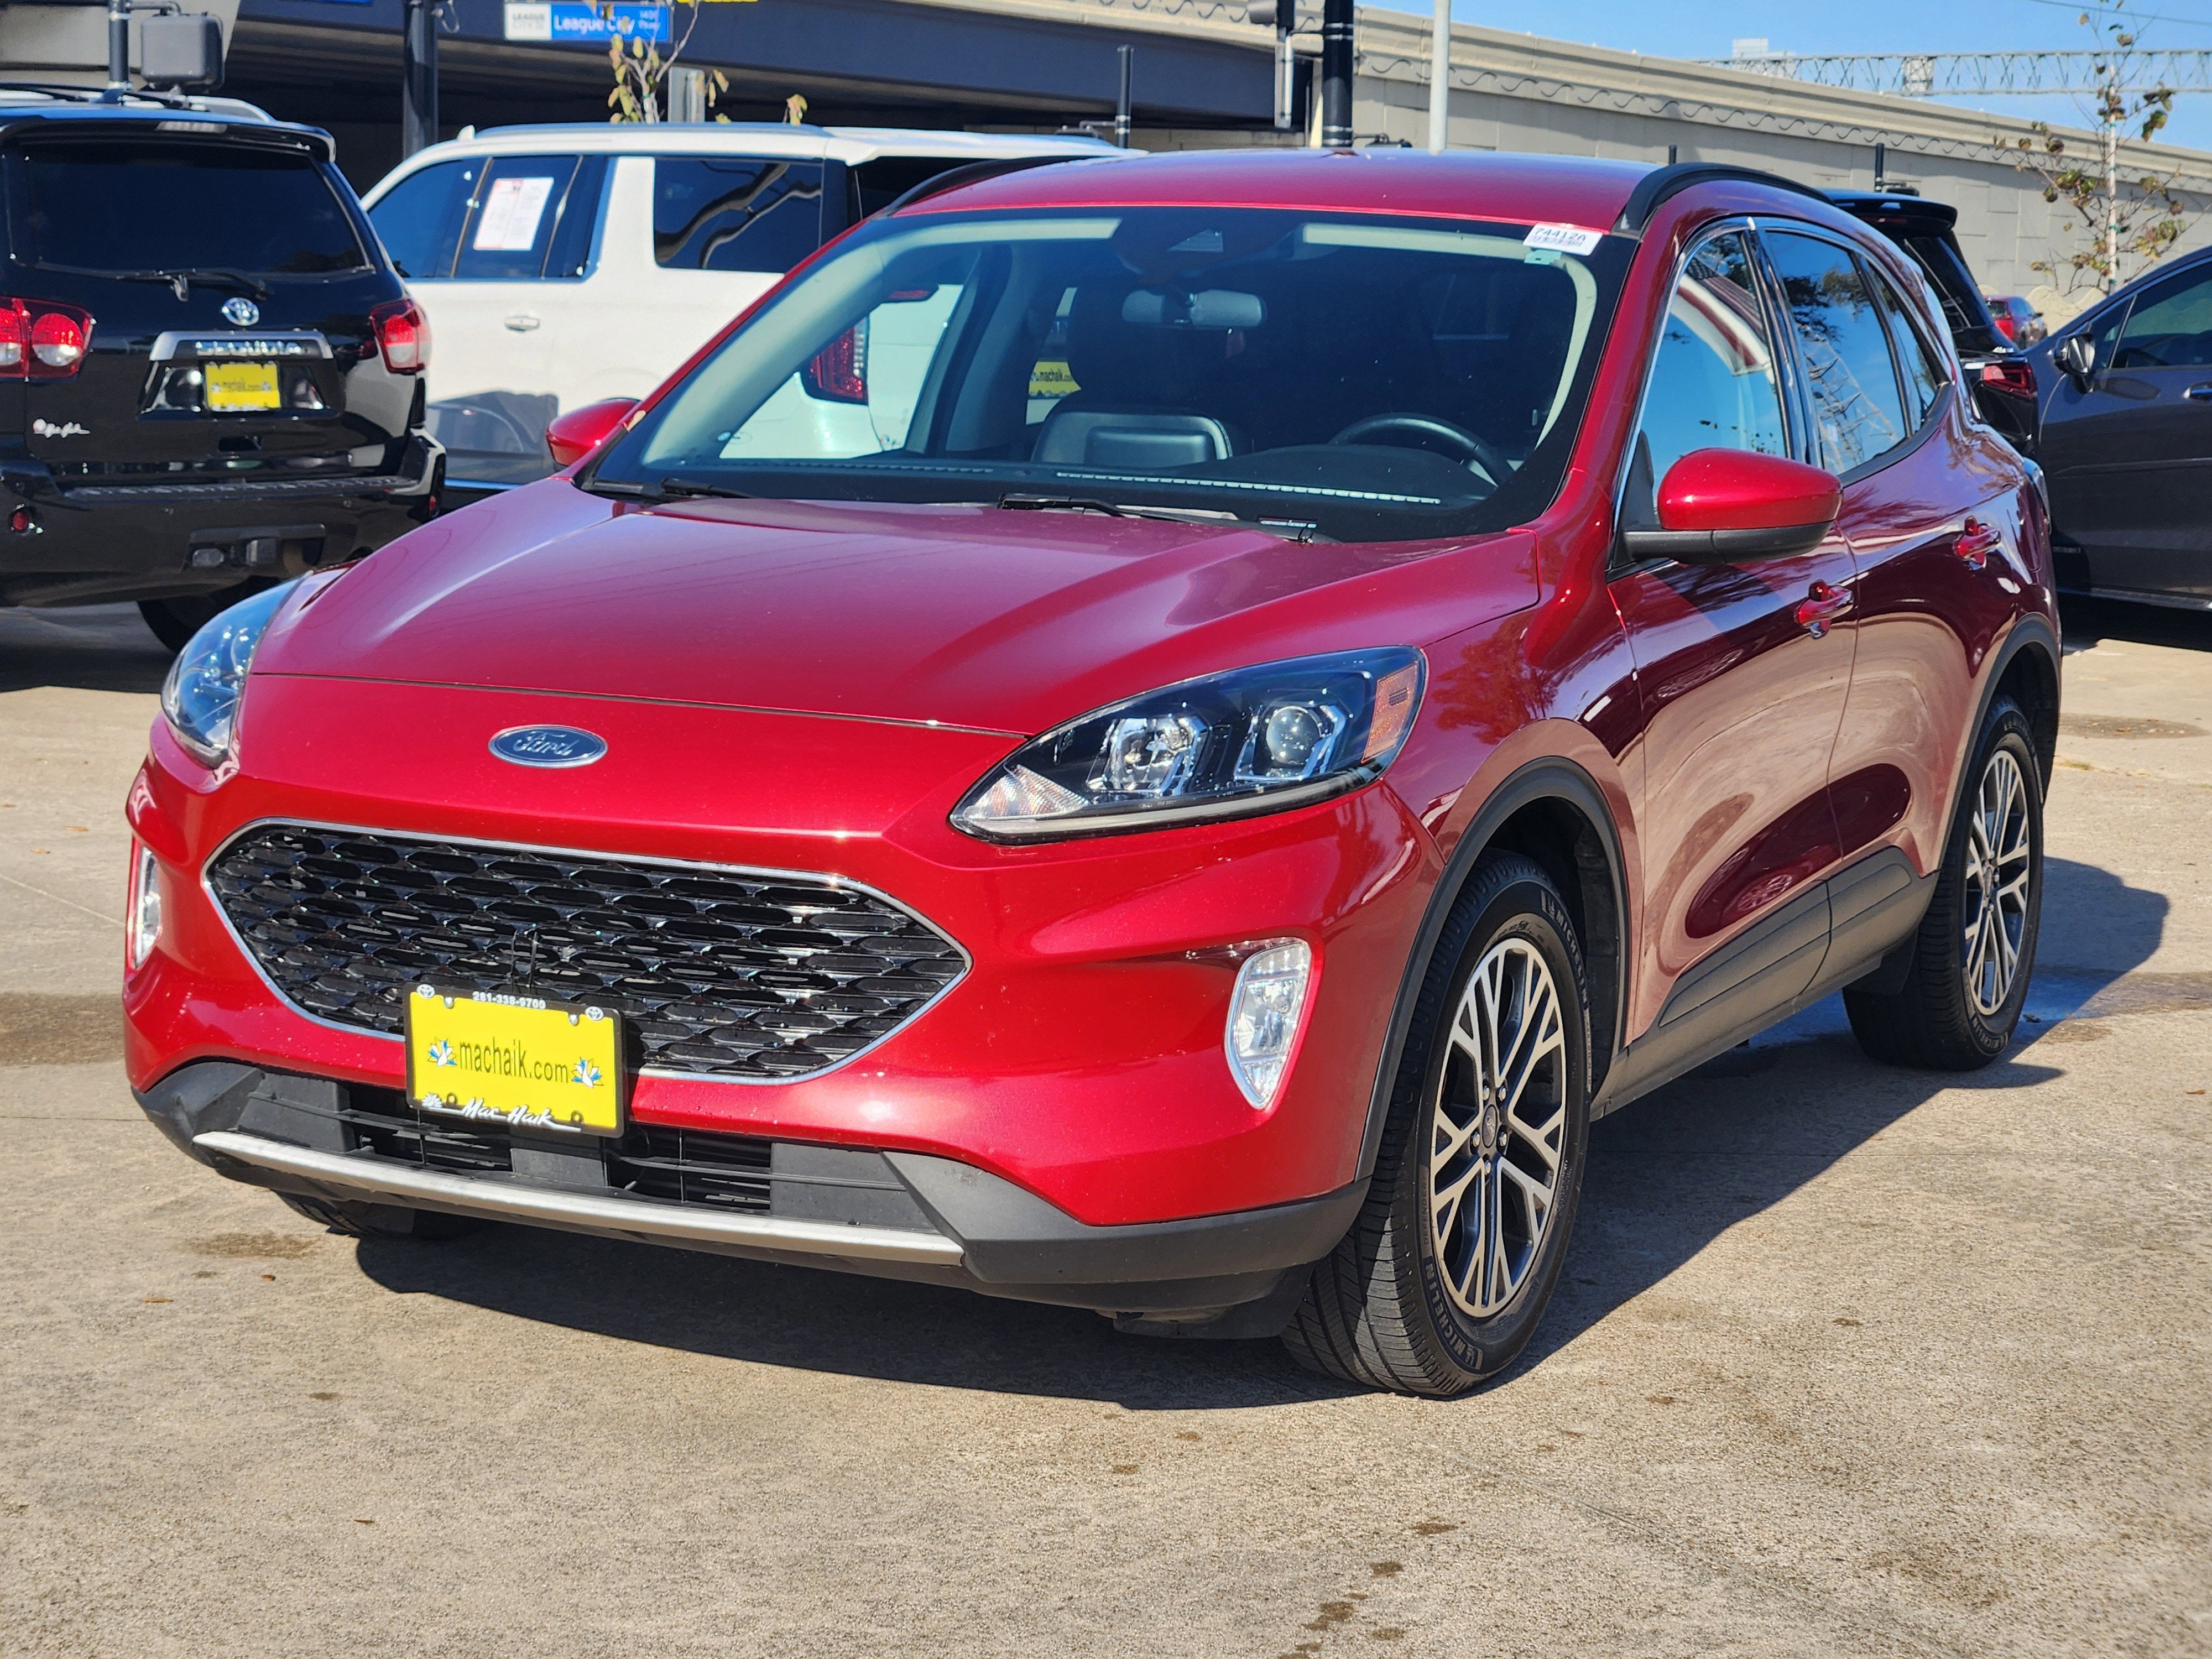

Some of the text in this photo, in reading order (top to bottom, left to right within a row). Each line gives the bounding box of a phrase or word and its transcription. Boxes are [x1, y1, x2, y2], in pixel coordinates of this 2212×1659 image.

[554, 15, 604, 34] League
[606, 15, 635, 35] Ciy
[1556, 909, 1588, 1004] MICHELIN
[472, 990, 546, 1010] 281-338-9700
[460, 1036, 569, 1083] machaik.com
[461, 1097, 507, 1119] Mac
[1425, 1263, 1466, 1356] MICHELIN
